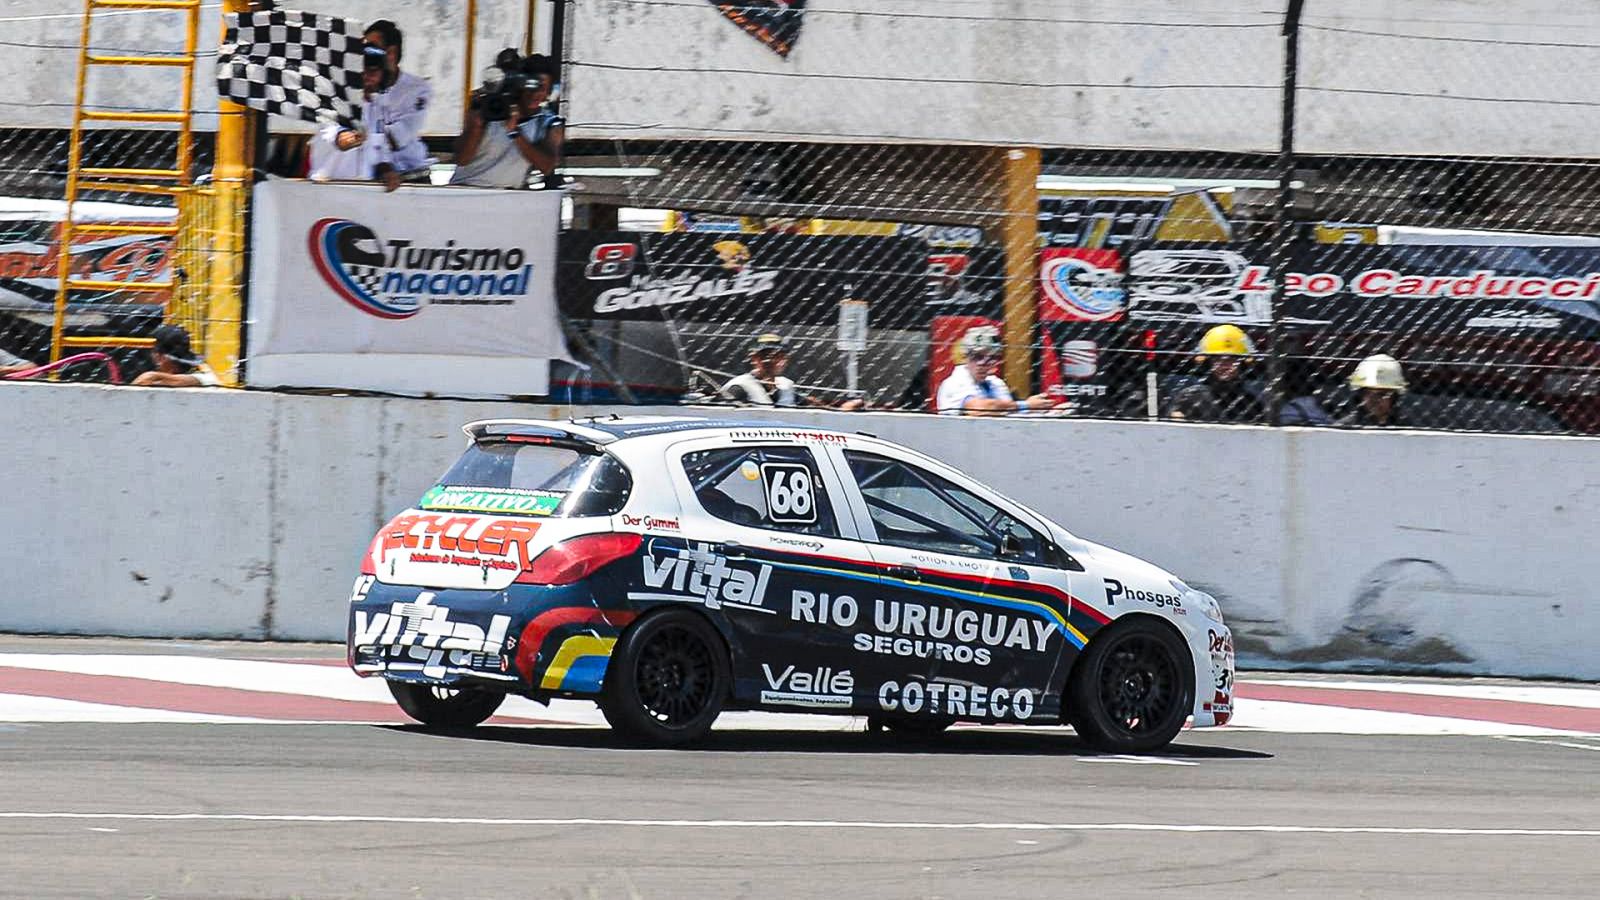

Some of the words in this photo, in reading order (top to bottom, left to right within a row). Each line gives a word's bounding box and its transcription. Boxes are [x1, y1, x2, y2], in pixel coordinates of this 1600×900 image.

[386, 239, 524, 270] Turismo
[382, 264, 535, 296] nacional
[1237, 266, 1345, 297] Leo
[1351, 268, 1600, 300] Carducci
[1049, 384, 1108, 396] SEAT
[769, 470, 812, 516] 68
[622, 514, 642, 526] Der
[643, 516, 681, 531] Gummi
[911, 554, 947, 565] MOTION
[1103, 578, 1182, 608] Phosgas
[791, 589, 859, 627] RIO
[874, 600, 1059, 652] URUGUAY
[853, 632, 992, 666] SEGUROS
[761, 663, 855, 694] Vallé
[878, 681, 1034, 719] COTRECO
